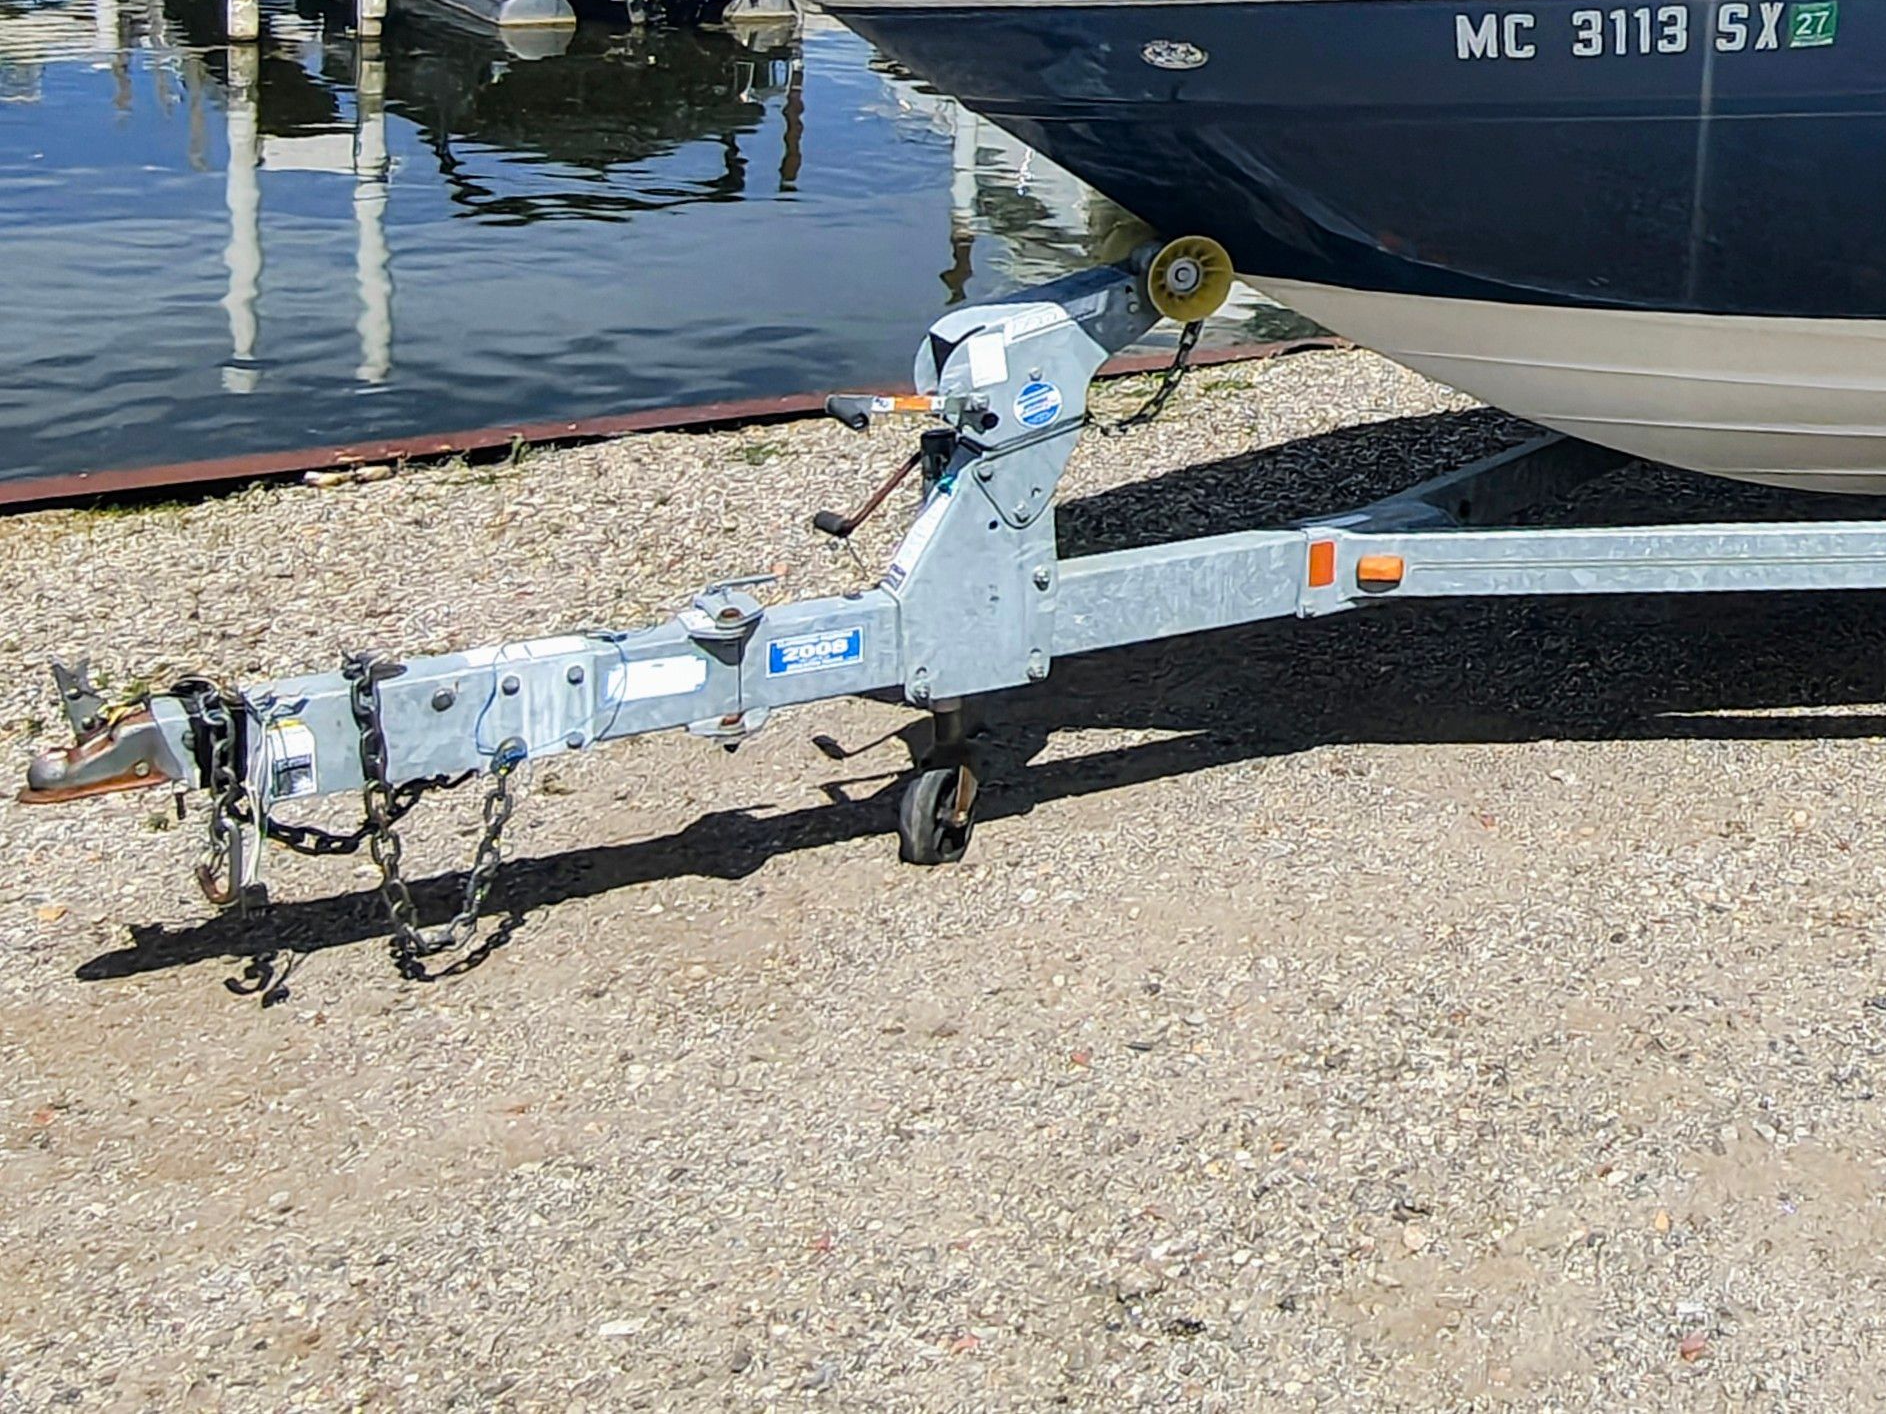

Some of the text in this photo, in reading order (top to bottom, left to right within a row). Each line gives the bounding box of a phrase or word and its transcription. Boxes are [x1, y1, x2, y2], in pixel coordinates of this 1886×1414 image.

[1455, 1, 1785, 59] MC 3113 SX
[1795, 11, 1830, 36] 27
[782, 638, 850, 663] 2008
